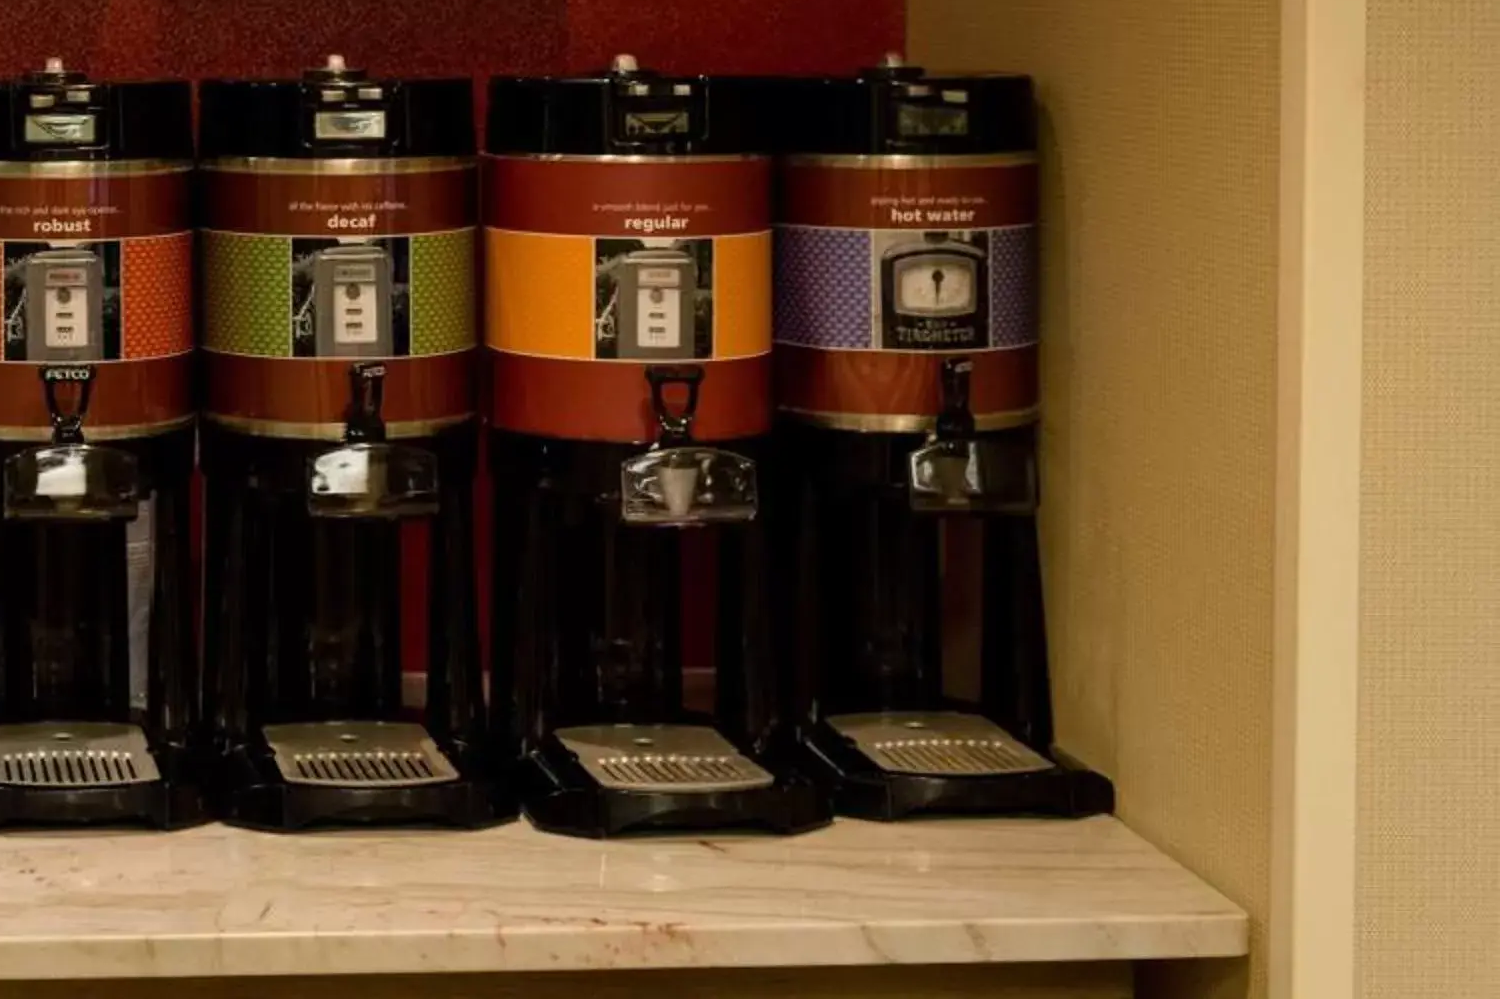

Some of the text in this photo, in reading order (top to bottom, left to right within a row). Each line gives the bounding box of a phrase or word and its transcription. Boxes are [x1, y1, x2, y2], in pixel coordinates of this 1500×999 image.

[326, 213, 376, 229] decaf
[891, 208, 976, 223] hot water
[33, 218, 92, 233] robust
[624, 215, 690, 233] regular
